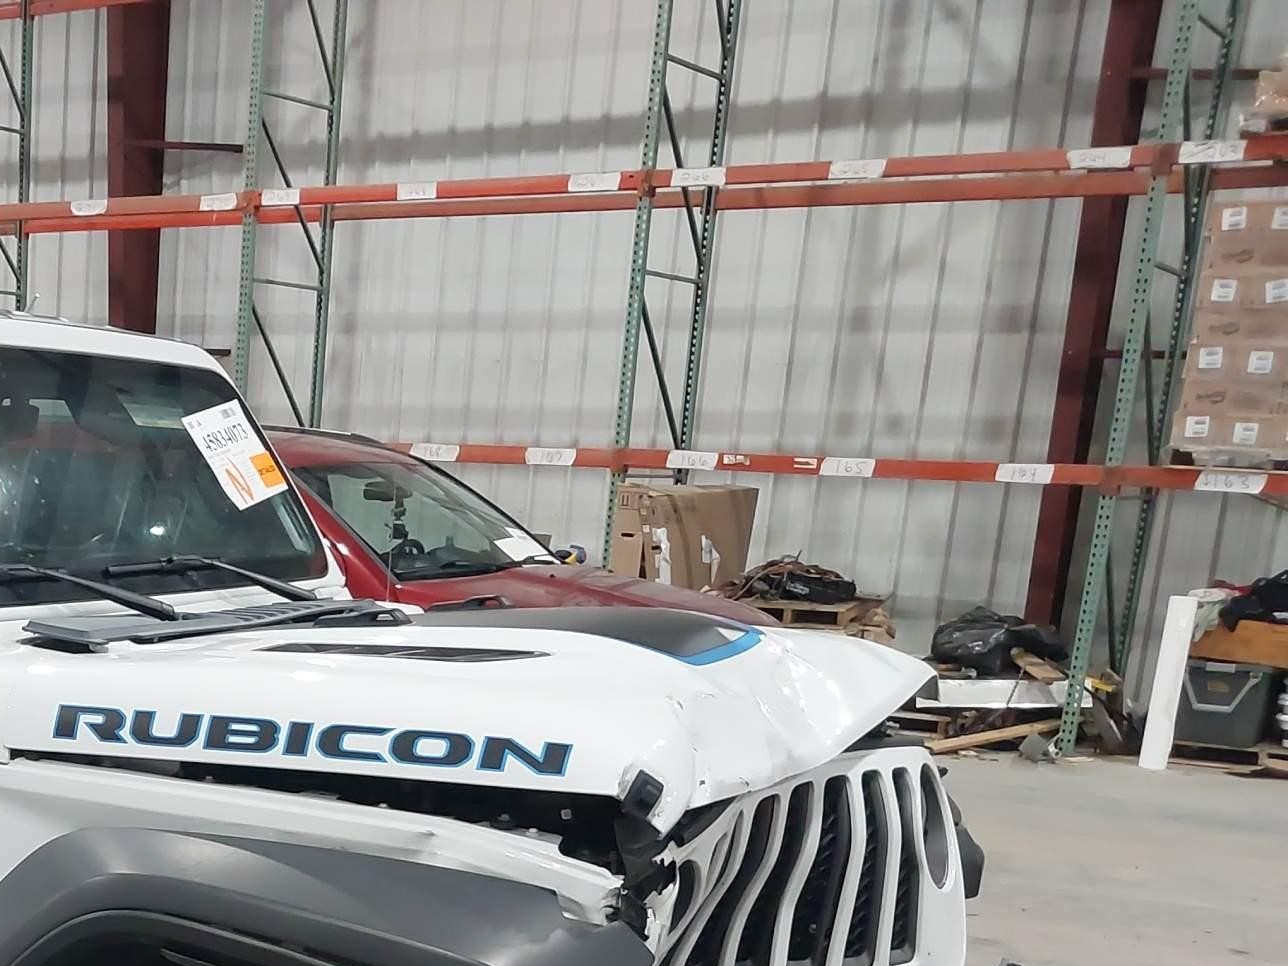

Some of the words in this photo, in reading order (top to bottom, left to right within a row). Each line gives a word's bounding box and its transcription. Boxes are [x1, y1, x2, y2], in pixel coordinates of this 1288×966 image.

[202, 423, 249, 452] 45834073
[835, 460, 868, 475] 165
[53, 703, 573, 777] RUBICON
